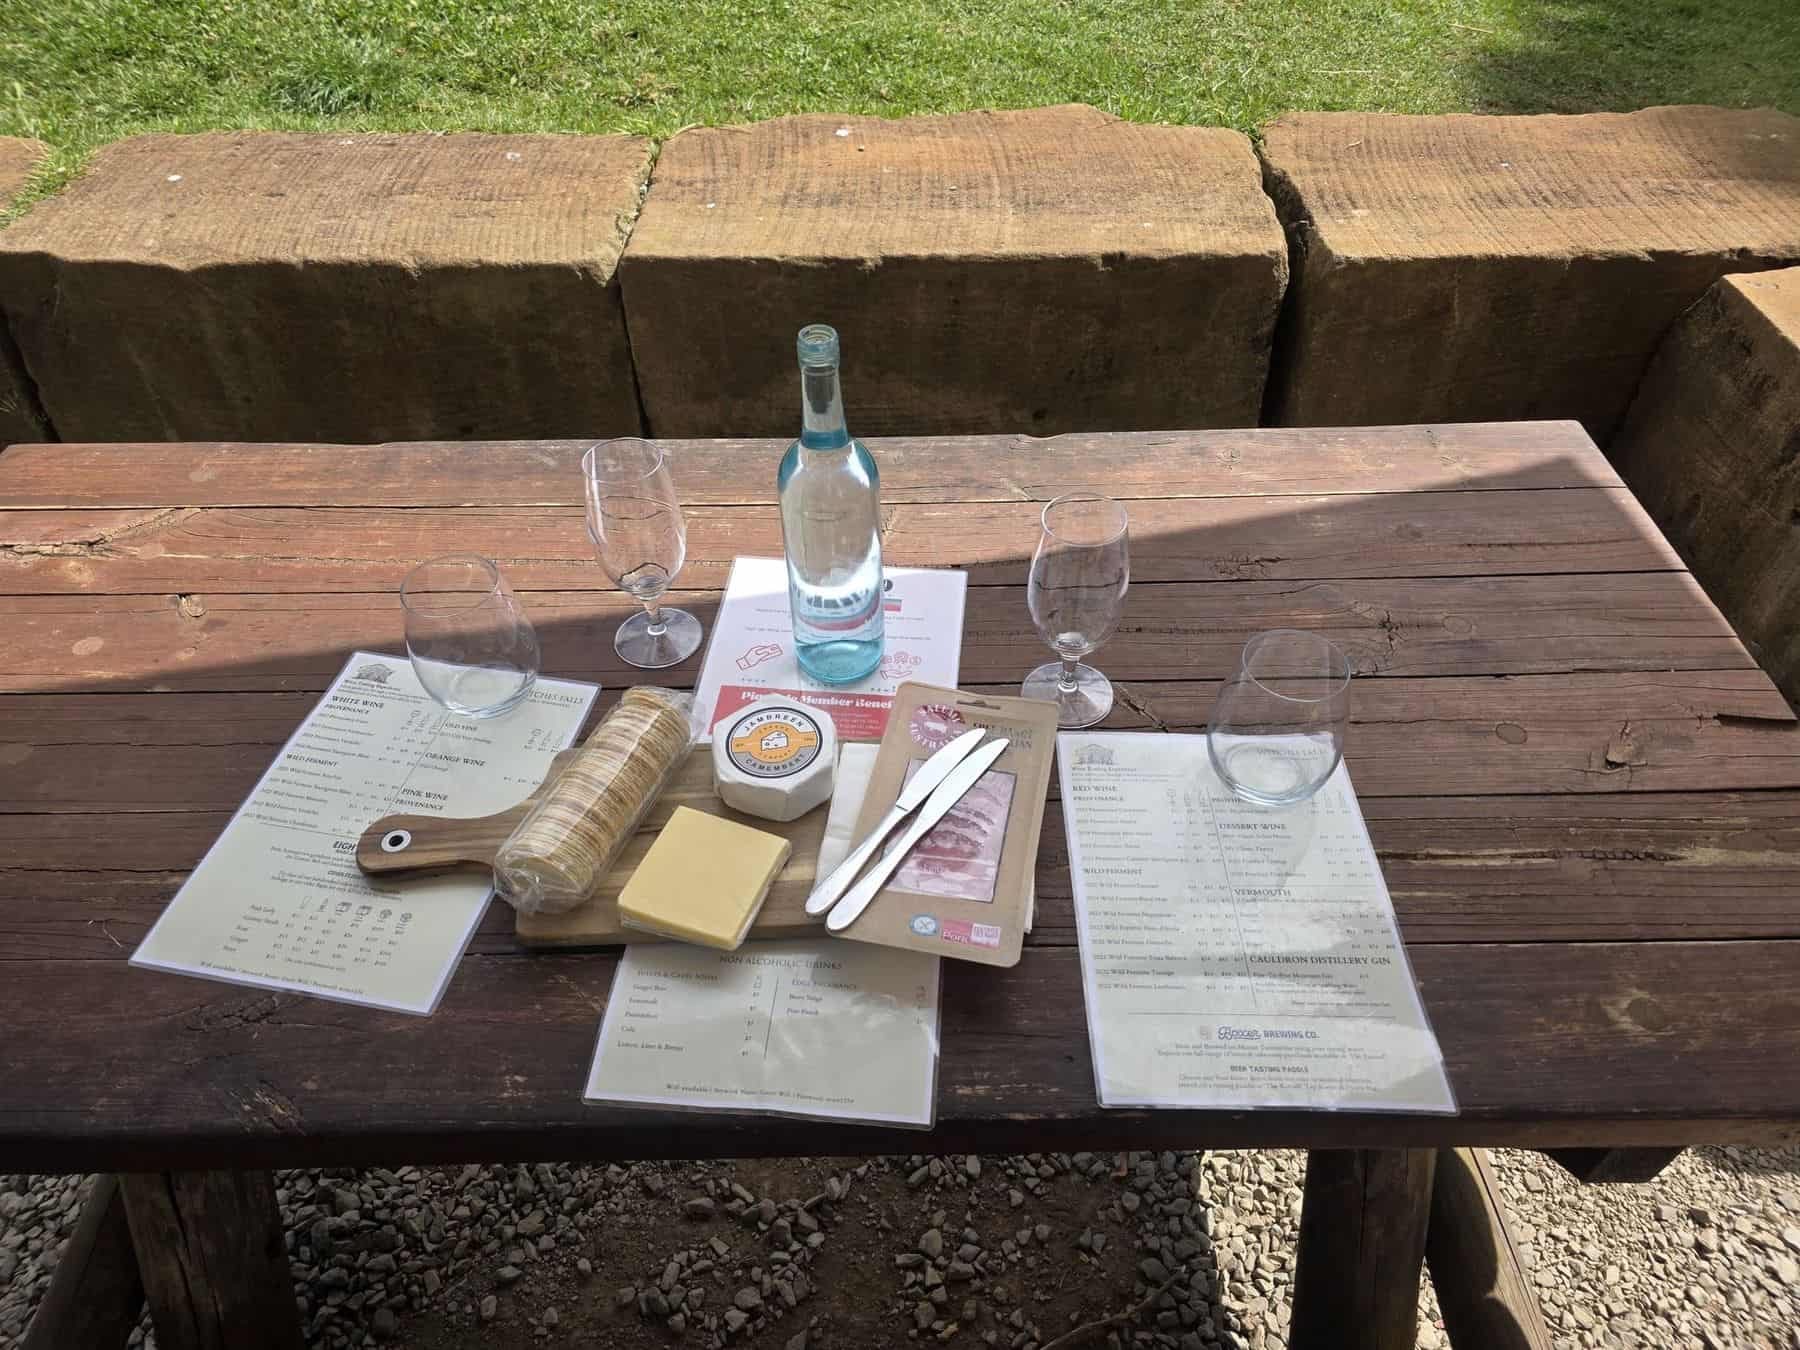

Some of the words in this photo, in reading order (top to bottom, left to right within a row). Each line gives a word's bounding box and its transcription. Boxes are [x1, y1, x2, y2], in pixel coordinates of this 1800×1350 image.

[331, 695, 361, 705] WHITE
[362, 699, 384, 709] WINE
[425, 752, 461, 764] ORANGE
[463, 757, 486, 768] WINE
[745, 753, 804, 771] CAMEMBERT
[402, 787, 424, 798] PINK
[425, 791, 448, 802] WINE
[1219, 823, 1259, 831] DESSERT
[1261, 823, 1288, 831] WINE
[1234, 888, 1292, 897] VERMOUTH
[719, 955, 743, 964] NON
[806, 960, 844, 970] DRINKS
[1250, 955, 1308, 965] CAULDRON
[1310, 956, 1368, 965] DISTILLERY
[1370, 957, 1392, 966] GIN
[1263, 1030, 1304, 1039] BREWING
